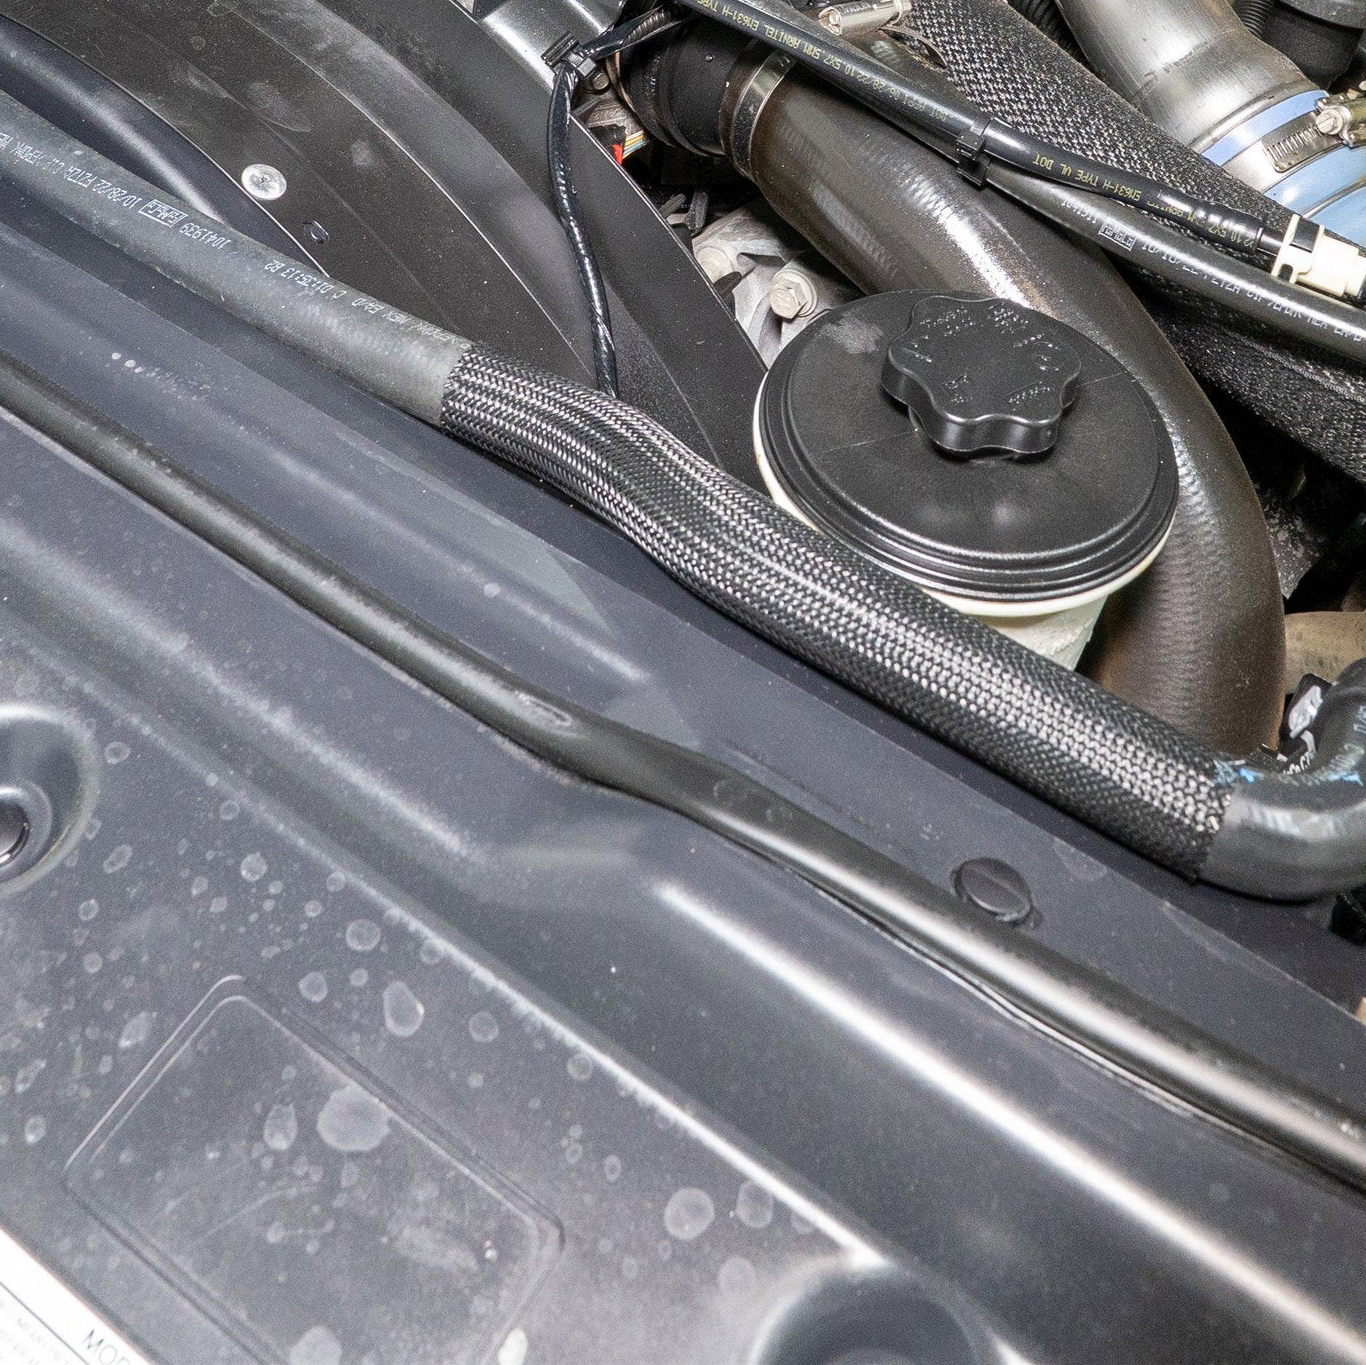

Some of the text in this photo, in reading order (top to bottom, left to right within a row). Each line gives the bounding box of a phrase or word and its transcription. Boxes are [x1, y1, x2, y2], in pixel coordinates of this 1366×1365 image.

[1031, 151, 1055, 171] DOT
[1073, 167, 1100, 188] TYPE
[91, 177, 144, 209] 10/28/22
[177, 218, 231, 252] 1041939
